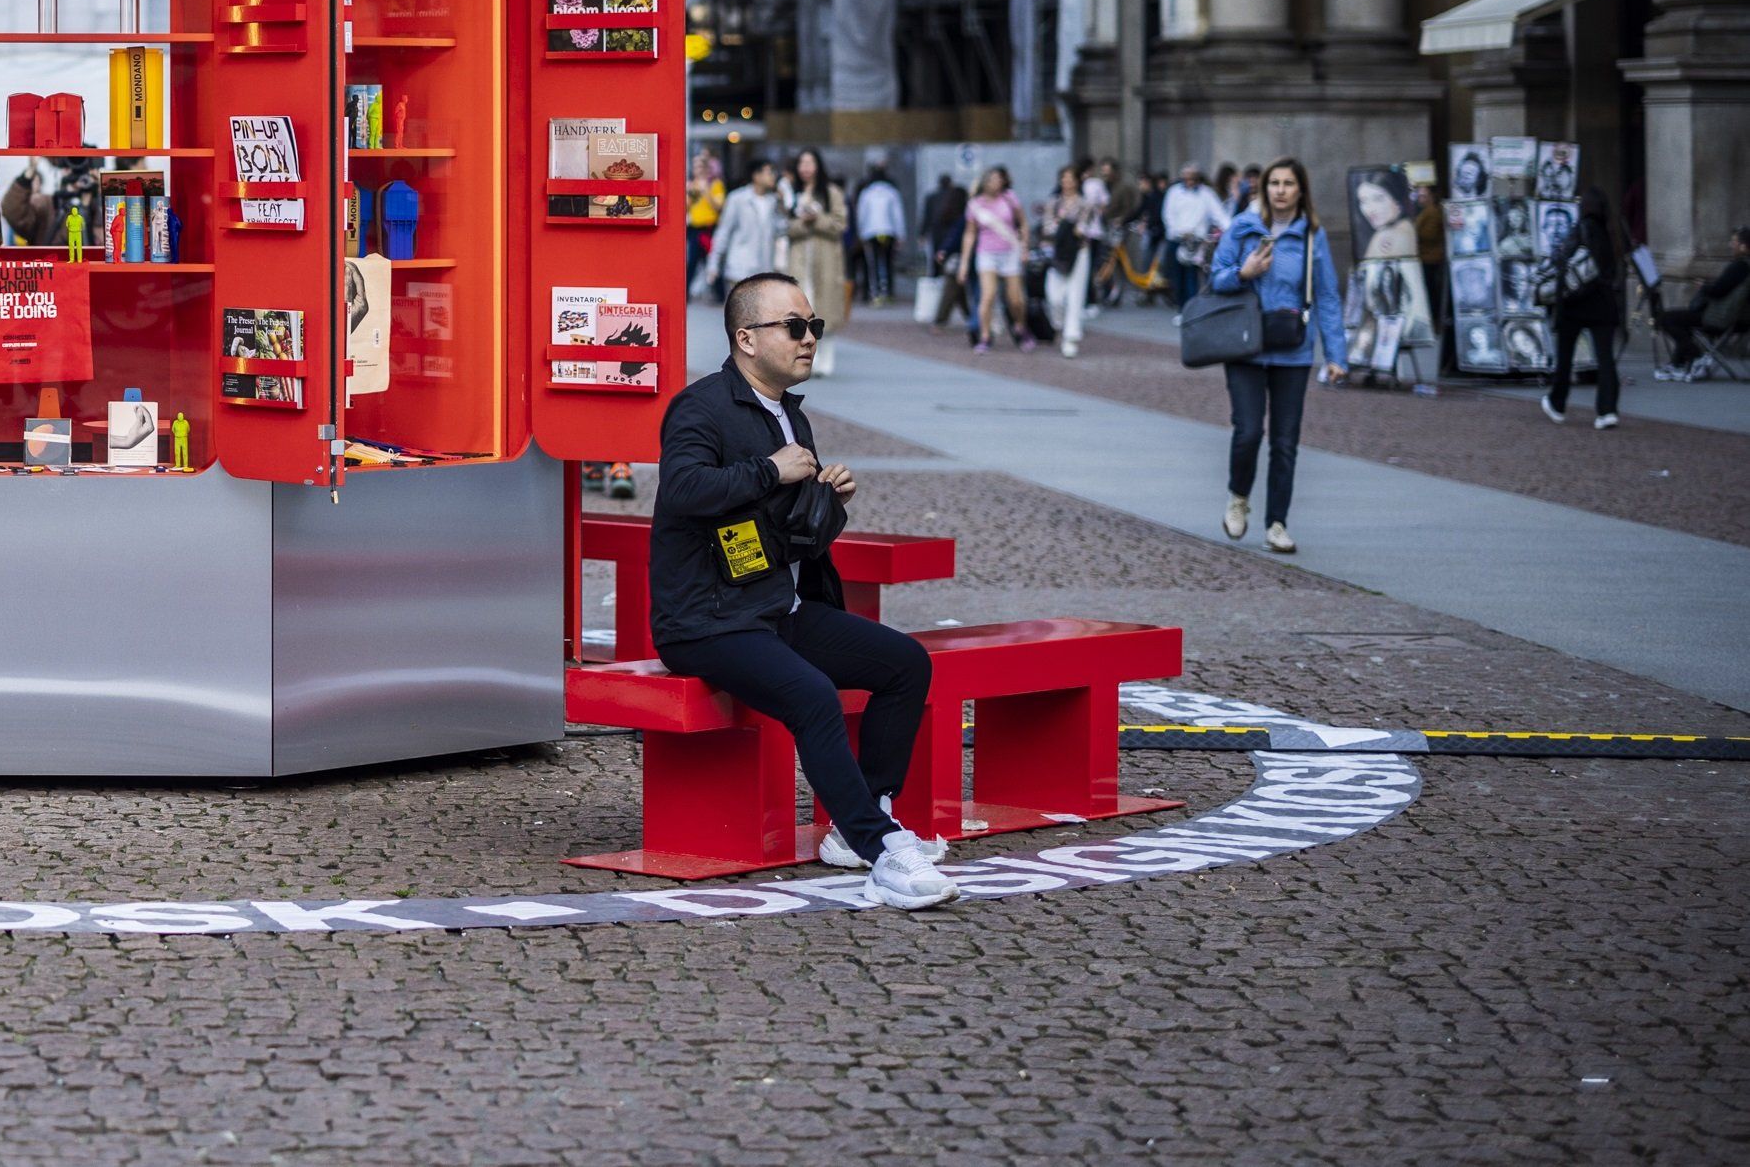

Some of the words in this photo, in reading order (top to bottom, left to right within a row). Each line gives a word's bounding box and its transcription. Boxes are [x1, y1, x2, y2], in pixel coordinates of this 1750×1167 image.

[133, 53, 142, 102] MONDANO
[232, 119, 280, 140] PIN-UP
[597, 138, 648, 153] EATEN
[235, 143, 290, 174] BODY
[257, 202, 283, 217] FEAT
[14, 267, 55, 281] DON'T
[25, 292, 55, 306] YOU
[556, 296, 604, 304] INVENTARIO
[13, 305, 58, 320] DOING
[598, 305, 653, 317] L'INTEGRALE
[226, 315, 238, 324] The
[258, 318, 268, 326] The
[233, 325, 254, 335] Journal
